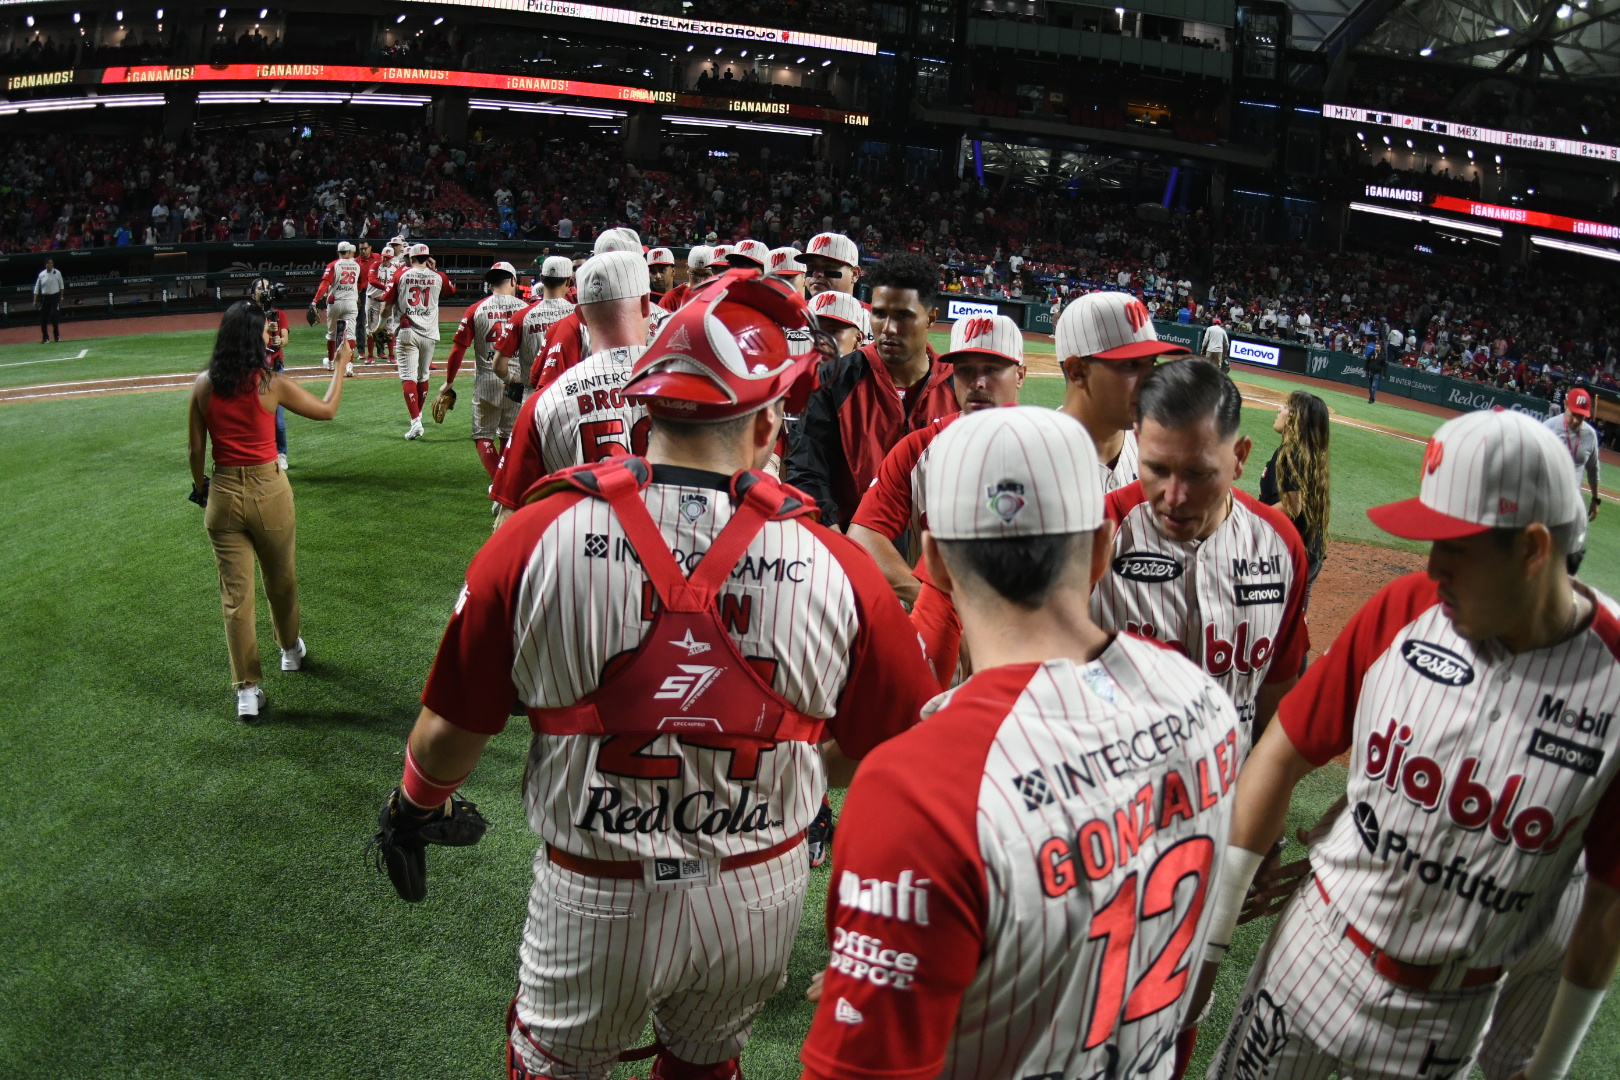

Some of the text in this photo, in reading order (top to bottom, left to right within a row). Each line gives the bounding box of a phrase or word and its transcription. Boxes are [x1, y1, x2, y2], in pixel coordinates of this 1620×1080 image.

[127, 67, 195, 83] ¡GANAMOS!
[256, 65, 324, 78] ¡GANAMOS!
[383, 67, 449, 80] ¡GANAMOS!
[8, 70, 74, 90] ¡GANAMOS!
[507, 77, 569, 91] ¡GANAMOS!
[618, 88, 676, 103] ¡GANAMOS!
[729, 100, 790, 115] ¡GANAMOS!
[1335, 107, 1357, 118] MTY
[1375, 115, 1382, 123] 0
[1430, 123, 1438, 131] 4
[1506, 133, 1544, 148] Entrada
[1366, 185, 1423, 202] ¡GANAMOS!
[1470, 204, 1526, 221] ¡GANAMOS!
[340, 271, 357, 285] 26
[407, 286, 431, 307] 31
[537, 308, 574, 318] INTERCERAM
[1234, 344, 1275, 360] Lenovo
[1395, 377, 1439, 392] INTERCERAMIC
[1448, 388, 1474, 406] Red
[1120, 556, 1177, 577] Fester
[1232, 555, 1282, 578] Mobil
[1240, 588, 1280, 601] Lenovo
[1404, 642, 1469, 684] Fester
[1537, 694, 1614, 740] Mobil
[1534, 737, 1595, 769] Lenovo
[575, 786, 671, 835] Red
[674, 785, 773, 836] Cola
[1036, 726, 1238, 899] GONZALEZ
[682, 860, 700, 868] NEW
[1382, 829, 1536, 914] Profutur
[1081, 833, 1216, 1051] 12
